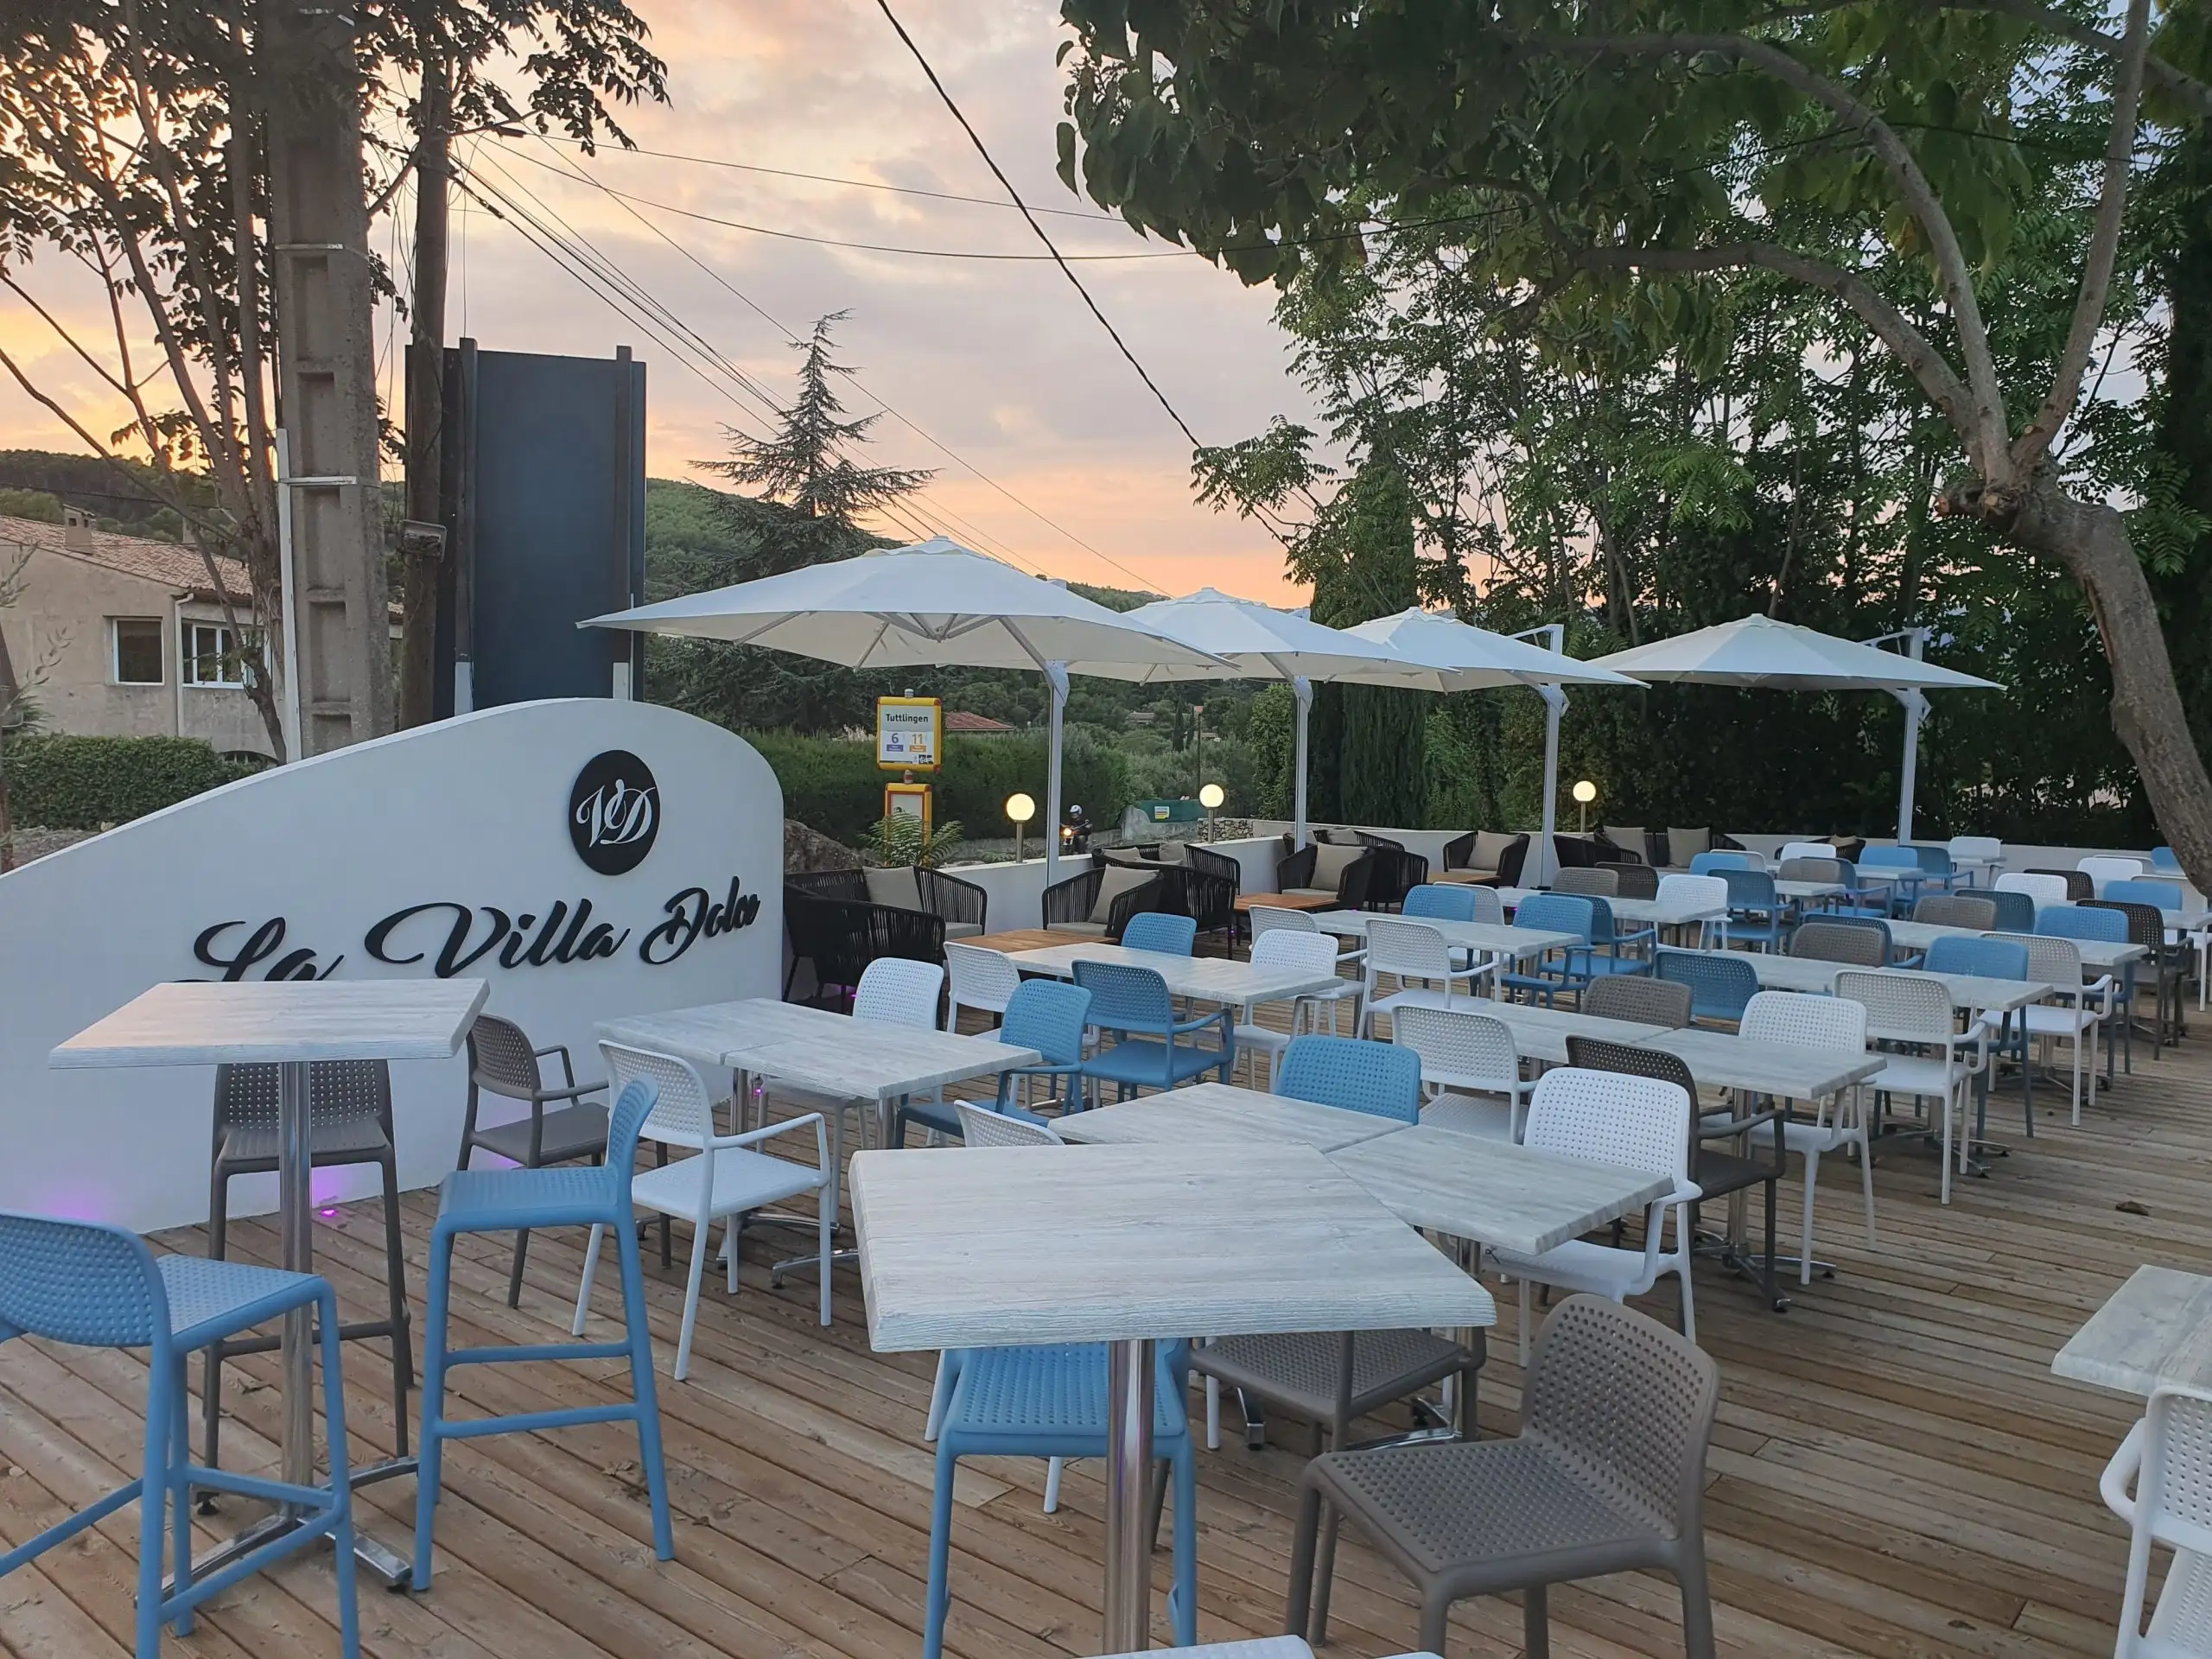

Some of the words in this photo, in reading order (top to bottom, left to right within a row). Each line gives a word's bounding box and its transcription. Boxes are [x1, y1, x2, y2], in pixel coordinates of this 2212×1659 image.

[886, 714, 929, 724] Tuttlingen
[892, 733, 899, 744] 6
[912, 734, 923, 744] 11
[175, 917, 344, 982] La
[364, 898, 631, 978] Villa
